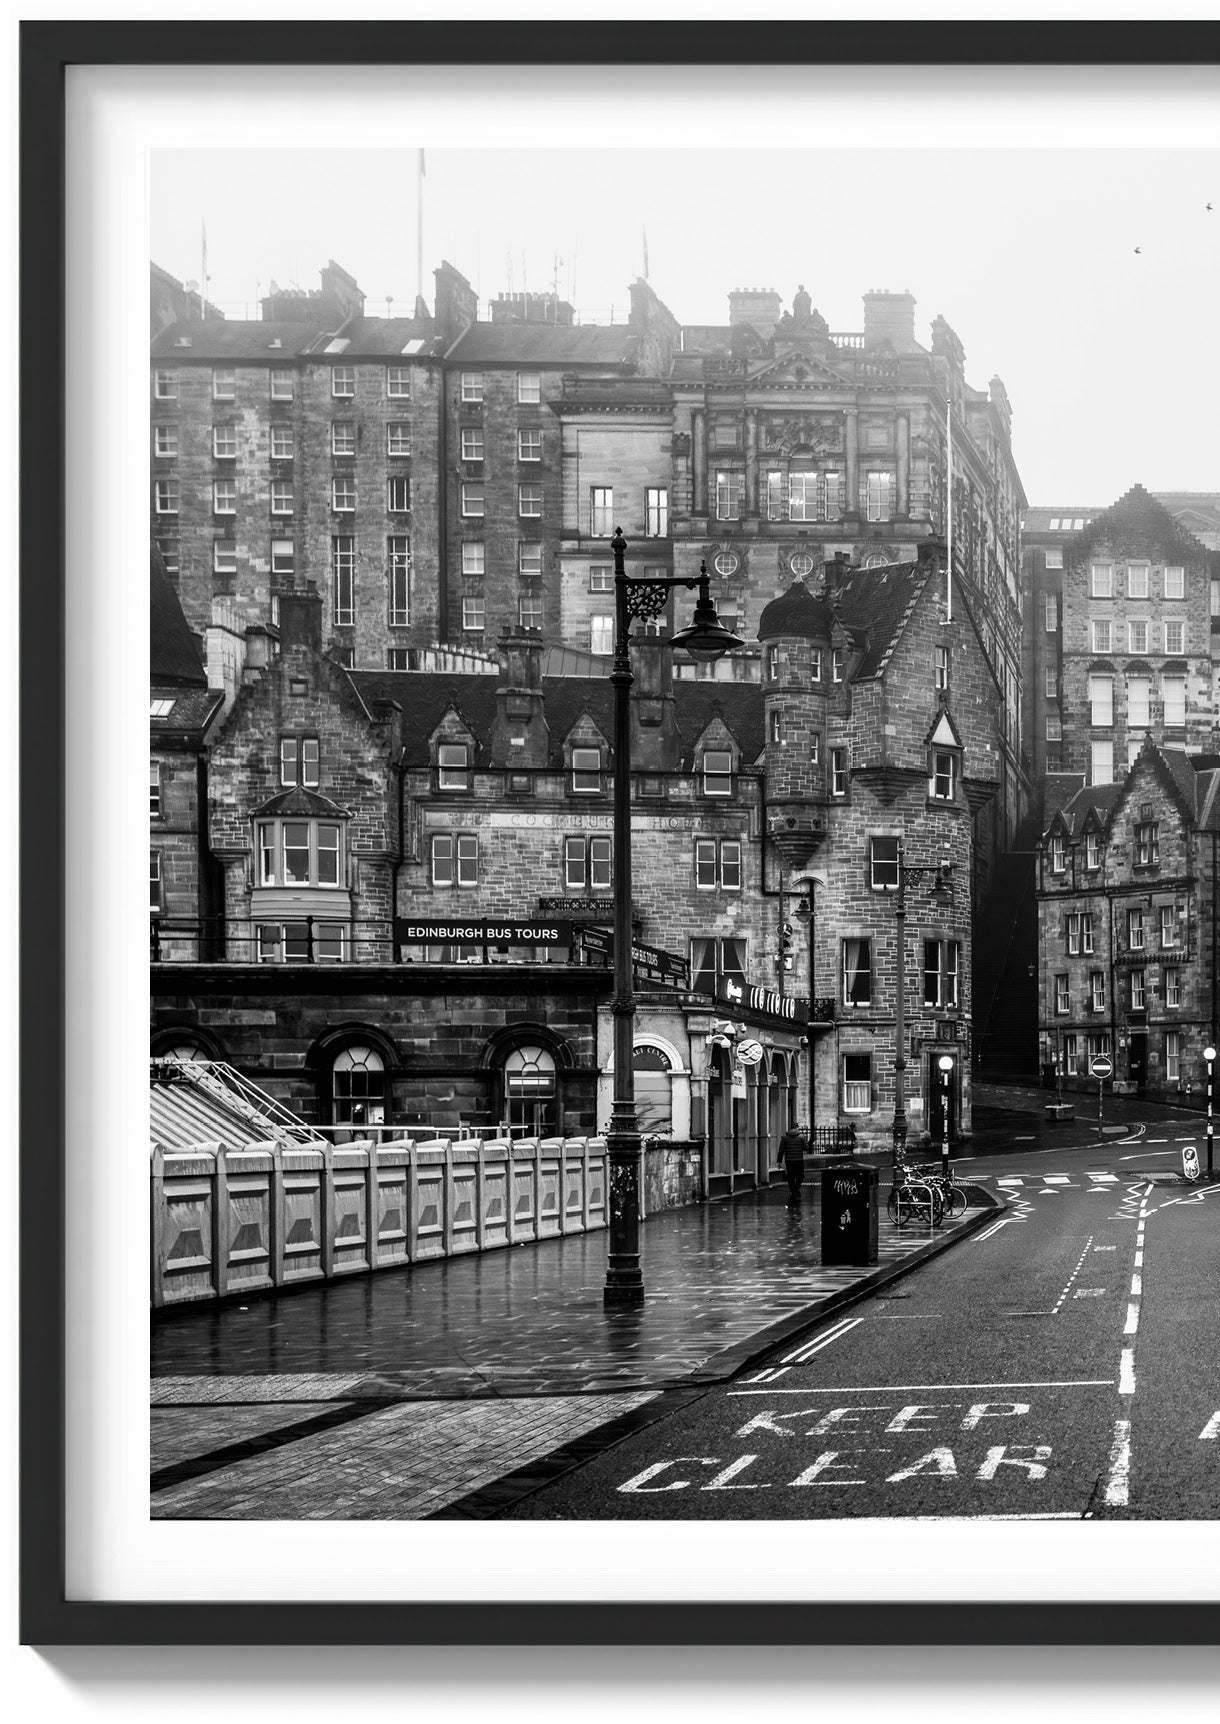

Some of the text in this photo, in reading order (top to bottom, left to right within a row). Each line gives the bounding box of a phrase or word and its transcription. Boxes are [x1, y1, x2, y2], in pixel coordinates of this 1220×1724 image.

[511, 814, 614, 829] COCKBUR
[407, 927, 559, 939] EDINBURGH BUS TOURS
[732, 1403, 1031, 1438] KEEP
[616, 1445, 1053, 1493] CLEAR
